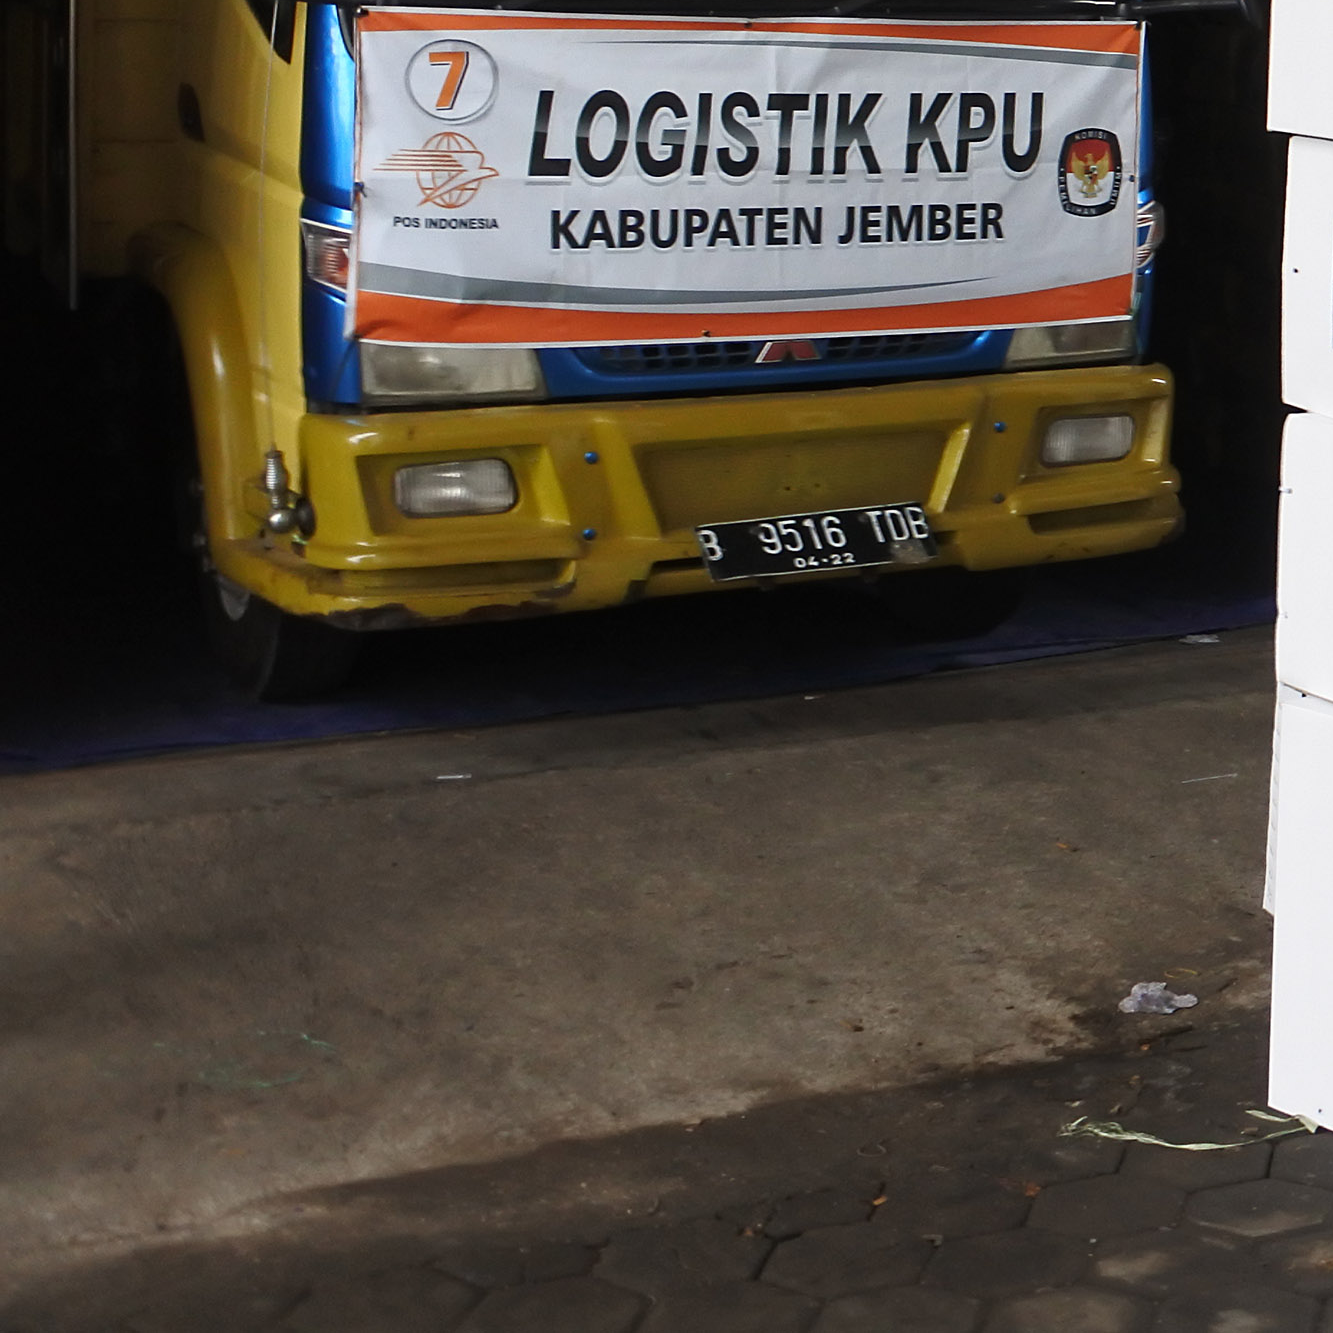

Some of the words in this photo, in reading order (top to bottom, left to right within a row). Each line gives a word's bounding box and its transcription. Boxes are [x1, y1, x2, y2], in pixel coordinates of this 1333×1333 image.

[428, 51, 469, 111] 7
[528, 89, 882, 179] LOGISTIK
[904, 92, 1044, 174] KPU
[393, 216, 421, 229] POS
[424, 217, 499, 230] INDONESIA
[551, 206, 823, 250] KABUPATEN
[838, 202, 1005, 246] JEMBER
[698, 529, 724, 561] B
[757, 516, 847, 555] 9516
[866, 507, 928, 543] TDB
